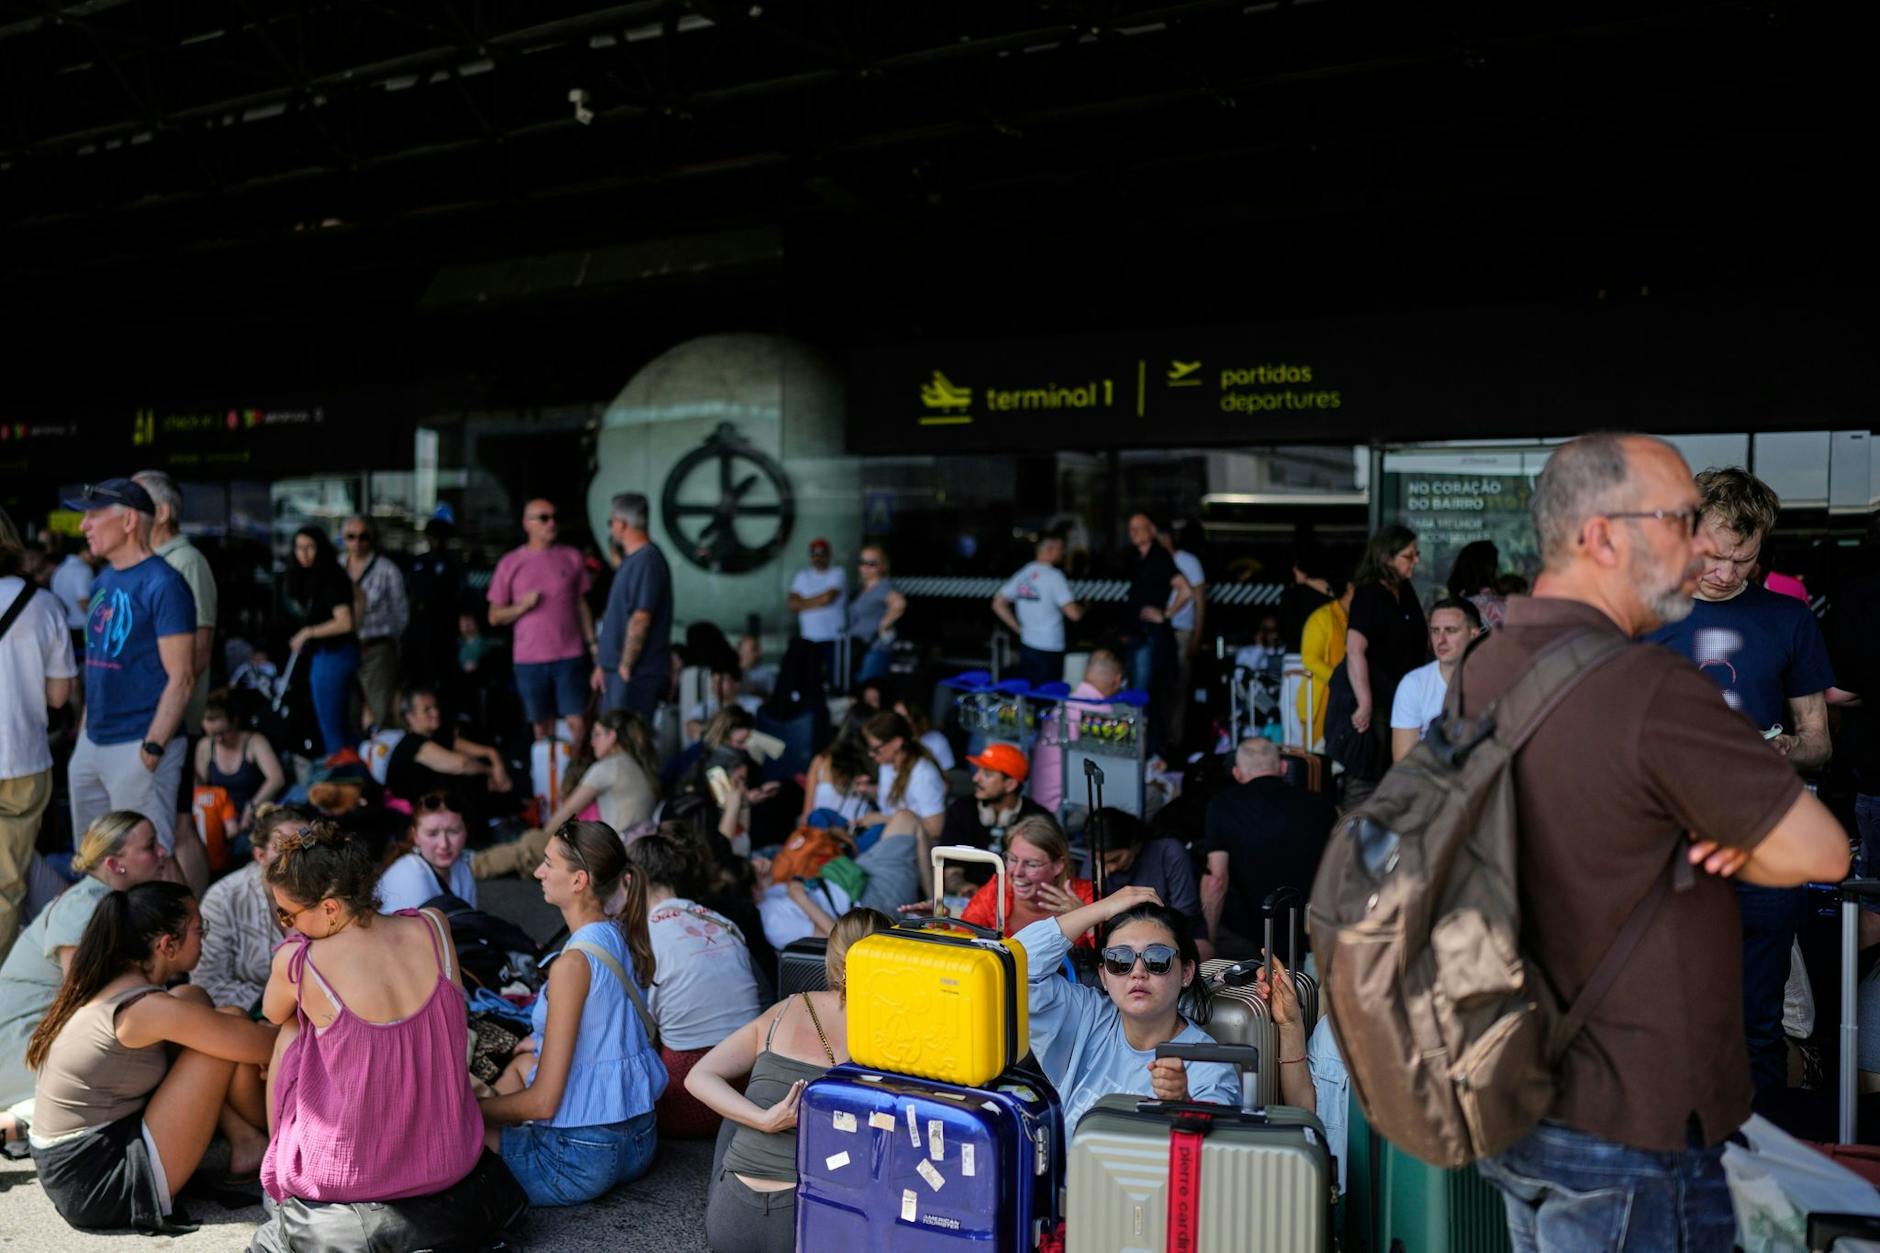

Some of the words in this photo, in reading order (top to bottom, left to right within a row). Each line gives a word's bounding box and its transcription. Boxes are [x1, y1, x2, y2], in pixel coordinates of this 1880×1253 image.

[1220, 364, 1312, 391] partidas
[986, 382, 1097, 411] terminal
[1103, 380, 1114, 406] 1
[1220, 387, 1341, 416] departures
[1408, 481, 1430, 495] NO
[1432, 479, 1502, 496] CORAÇÃO
[1408, 497, 1430, 510] DO
[1432, 497, 1484, 510] BAIRRO
[1178, 1146, 1191, 1197] pierre
[922, 1214, 960, 1226] AMERICAN
[922, 1218, 960, 1230] TOURISTER
[1177, 1201, 1191, 1253] cardin
